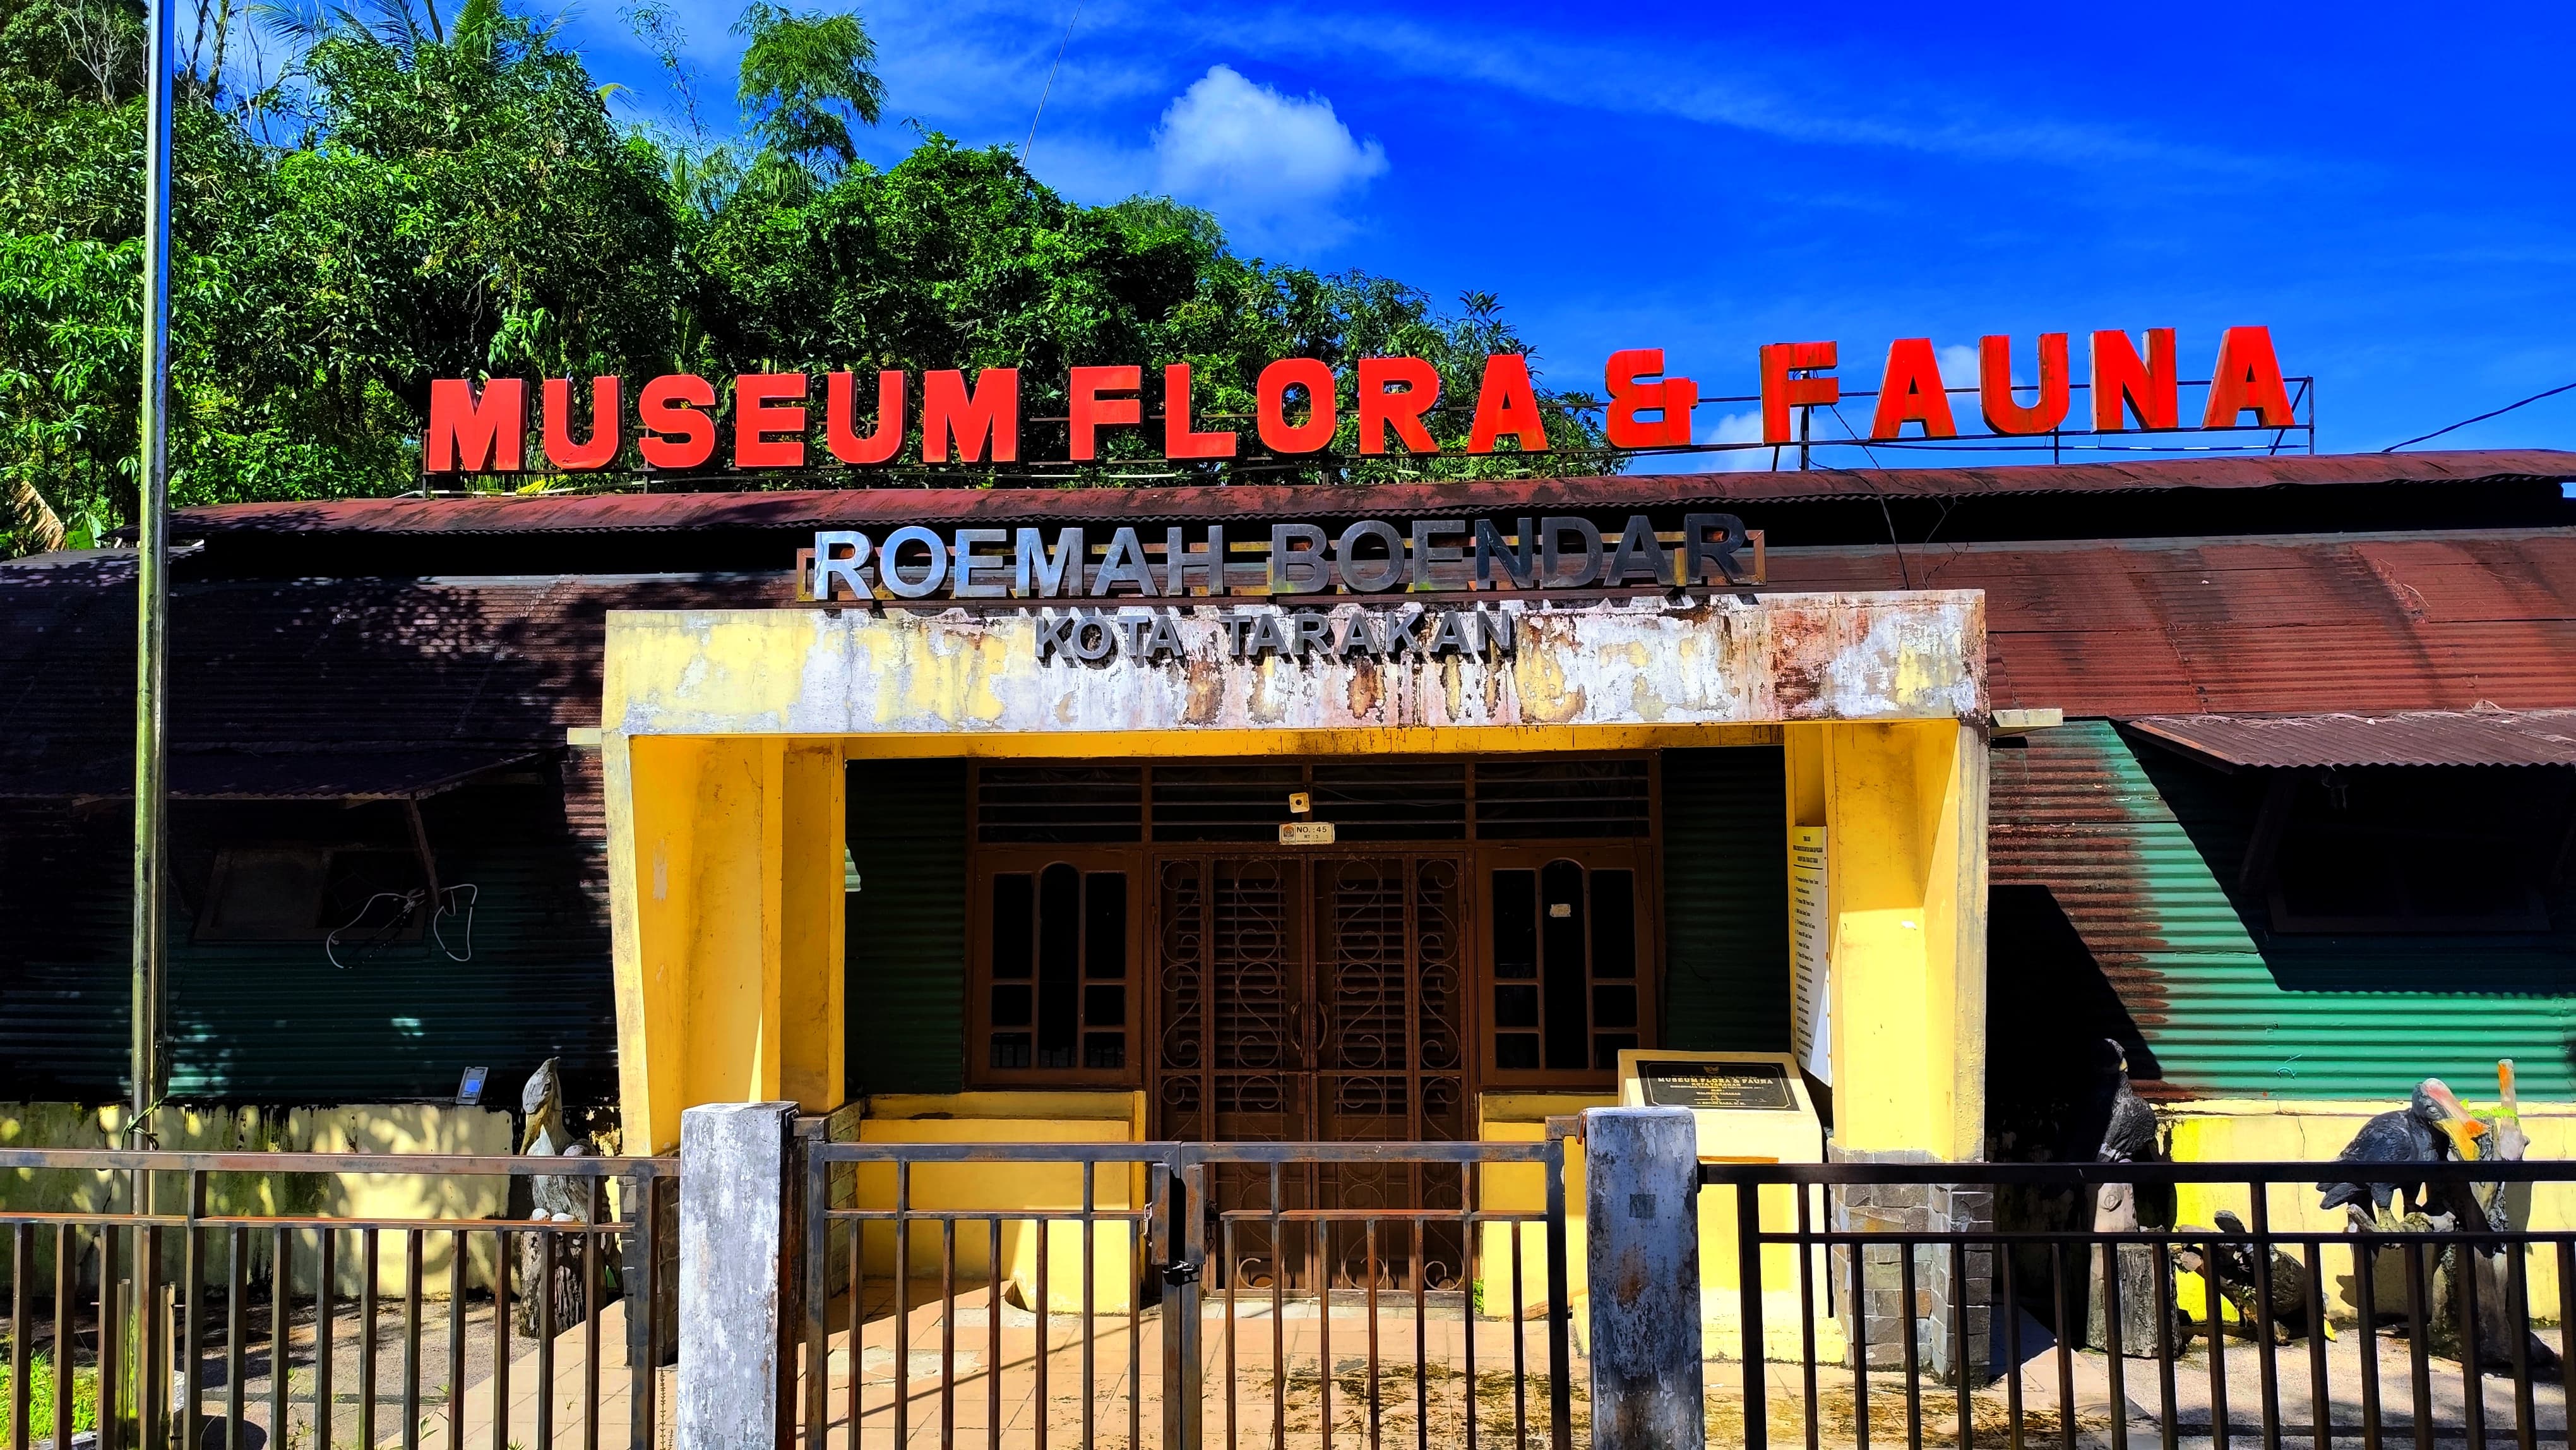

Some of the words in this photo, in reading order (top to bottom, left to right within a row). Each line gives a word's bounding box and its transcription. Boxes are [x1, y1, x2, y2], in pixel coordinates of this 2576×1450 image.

[427, 366, 1022, 474] MUSEUM
[1068, 353, 1549, 462] FLORA
[1604, 349, 1698, 448] &
[1759, 325, 2296, 446] FAUNA
[813, 525, 1225, 601] ROEMAH
[1271, 513, 1749, 594] BOENDAR
[1034, 614, 1184, 659] KOTA
[1219, 609, 1515, 656] TARAKAN
